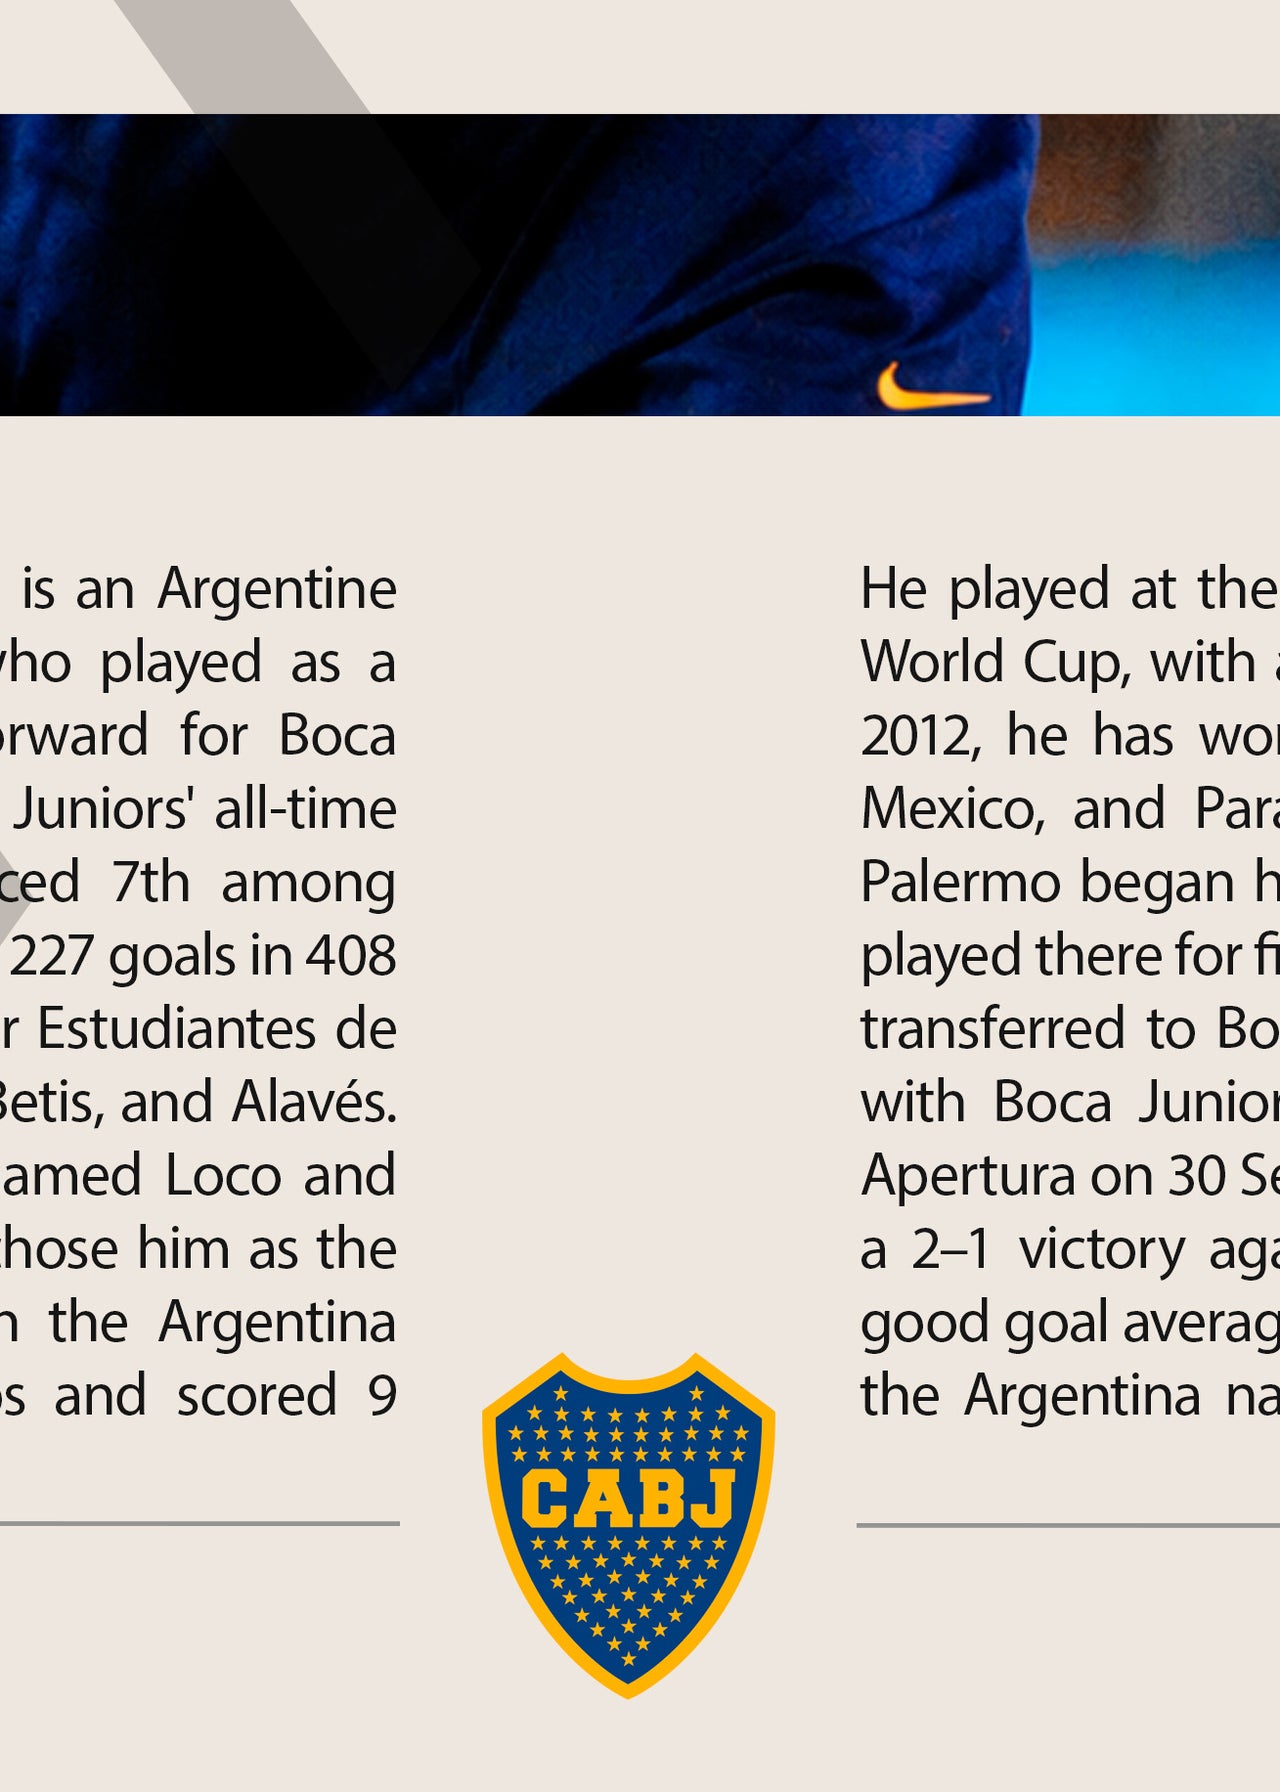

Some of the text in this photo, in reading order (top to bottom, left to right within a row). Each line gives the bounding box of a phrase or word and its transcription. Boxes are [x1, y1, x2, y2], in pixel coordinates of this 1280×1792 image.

[22, 564, 56, 611] is
[75, 576, 134, 611] an
[155, 564, 398, 623] Argentine
[862, 564, 928, 611] He
[950, 562, 1109, 622] played
[1130, 567, 1178, 611] at
[1196, 562, 1279, 611] the
[179, 709, 250, 758] for
[280, 710, 396, 758] Boca
[860, 712, 983, 764] 2012,
[1008, 709, 1069, 758] he
[1094, 709, 1175, 758] has
[11, 784, 195, 831] Juniors'
[214, 782, 398, 831] all-time
[862, 784, 1046, 837] Mexico,
[1073, 782, 1165, 831] and
[9, 932, 96, 977] 227
[108, 929, 237, 989] goals
[250, 931, 293, 977] in
[304, 932, 397, 978] 408
[862, 928, 1022, 989] played
[1033, 929, 1164, 978] there
[1173, 929, 1244, 978] for
[39, 1002, 317, 1051] Estudiantes
[335, 1002, 398, 1051] de
[859, 1075, 966, 1124] with
[995, 1077, 1112, 1124] Boca
[167, 1150, 283, 1198] Loco
[303, 1149, 396, 1198] and
[859, 1236, 887, 1271] a
[1017, 1224, 1188, 1282] victory
[47, 1295, 129, 1344] the
[156, 1297, 396, 1356] Argentina
[54, 1369, 146, 1418] and
[177, 1369, 337, 1418] scored
[367, 1372, 398, 1418] 9
[858, 1369, 941, 1418] the
[962, 1370, 1201, 1429] Argentina
[520, 1467, 738, 1530] CABJ
